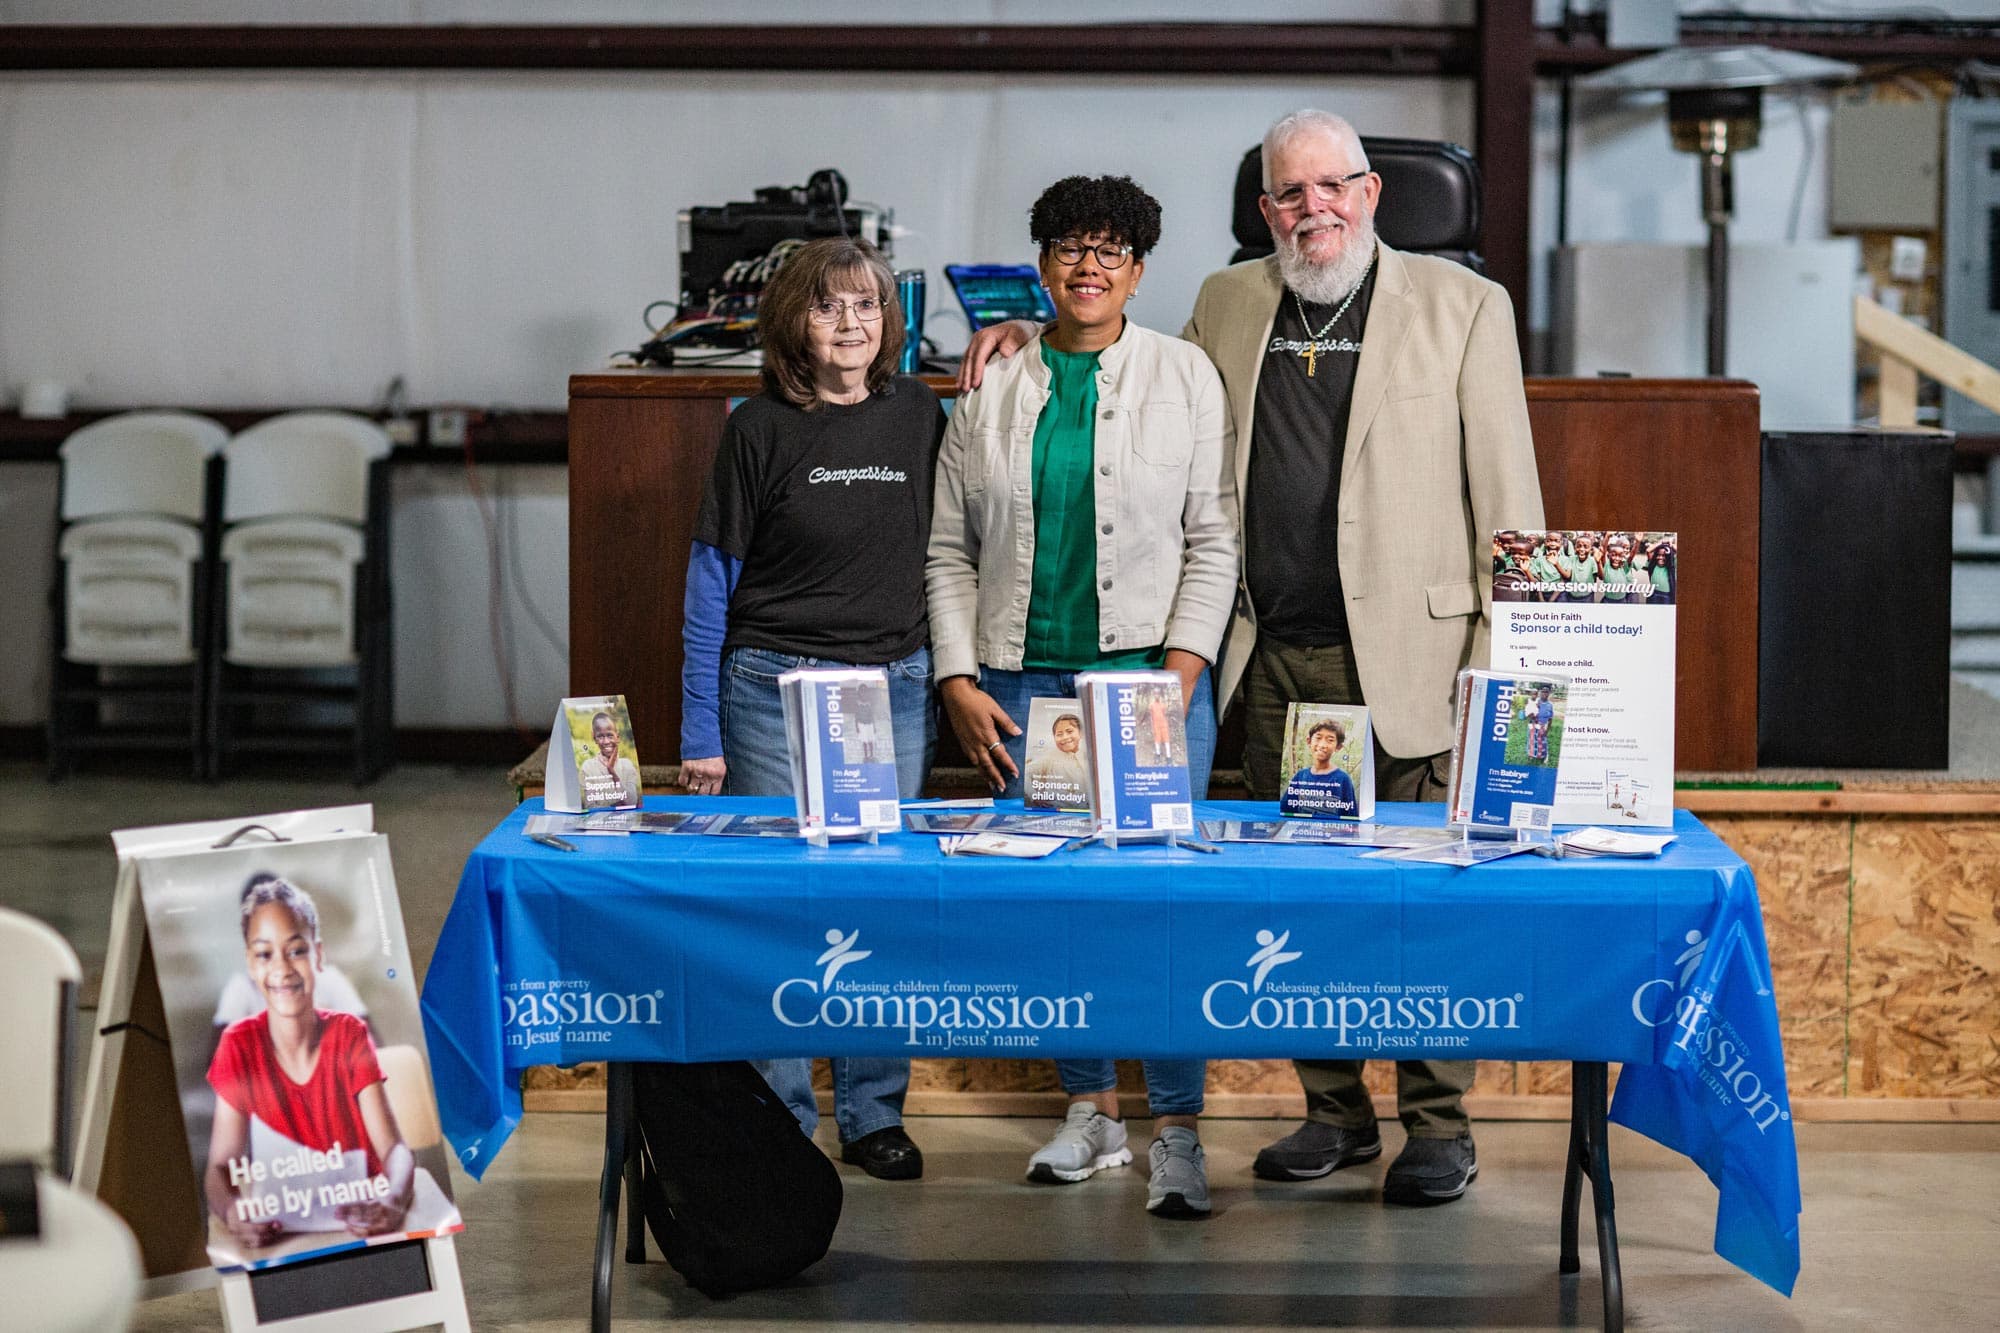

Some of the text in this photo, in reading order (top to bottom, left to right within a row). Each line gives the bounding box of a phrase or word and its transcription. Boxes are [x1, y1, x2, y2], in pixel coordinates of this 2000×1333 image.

[808, 465, 907, 486] Compassion
[1511, 578, 1656, 597] COMPASSION sunday
[1511, 612, 1582, 621] Step Out in Faith
[1511, 623, 1643, 636] Sponsor a child today!
[1519, 657, 1528, 668] 1.
[1536, 659, 1566, 667] Choose
[1574, 659, 1595, 668] child.
[826, 686, 845, 743] Hello!
[1118, 689, 1137, 746] Hello!
[1492, 685, 1515, 742] Hello!
[585, 781, 615, 792] Support
[1031, 781, 1073, 792] Sponsor
[1287, 787, 1325, 797] Become
[586, 790, 627, 802] child today!
[1031, 792, 1086, 804] child today!
[1287, 799, 1354, 810] sponsor today!
[520, 979, 545, 990] from
[548, 979, 591, 992] poverty
[835, 981, 1018, 995] Releasing children from poverty
[1265, 982, 1449, 996] Releasing children from poverty
[772, 978, 1090, 1046] Compassion
[1202, 980, 1520, 1047] Compassion
[566, 1029, 612, 1042] name
[926, 1032, 943, 1046] in
[993, 1034, 1039, 1047] name
[1356, 1033, 1373, 1047] in
[1423, 1035, 1469, 1047] name
[1700, 1068, 1732, 1106] name
[228, 1140, 345, 1187] He called
[235, 1173, 391, 1221] me by name
